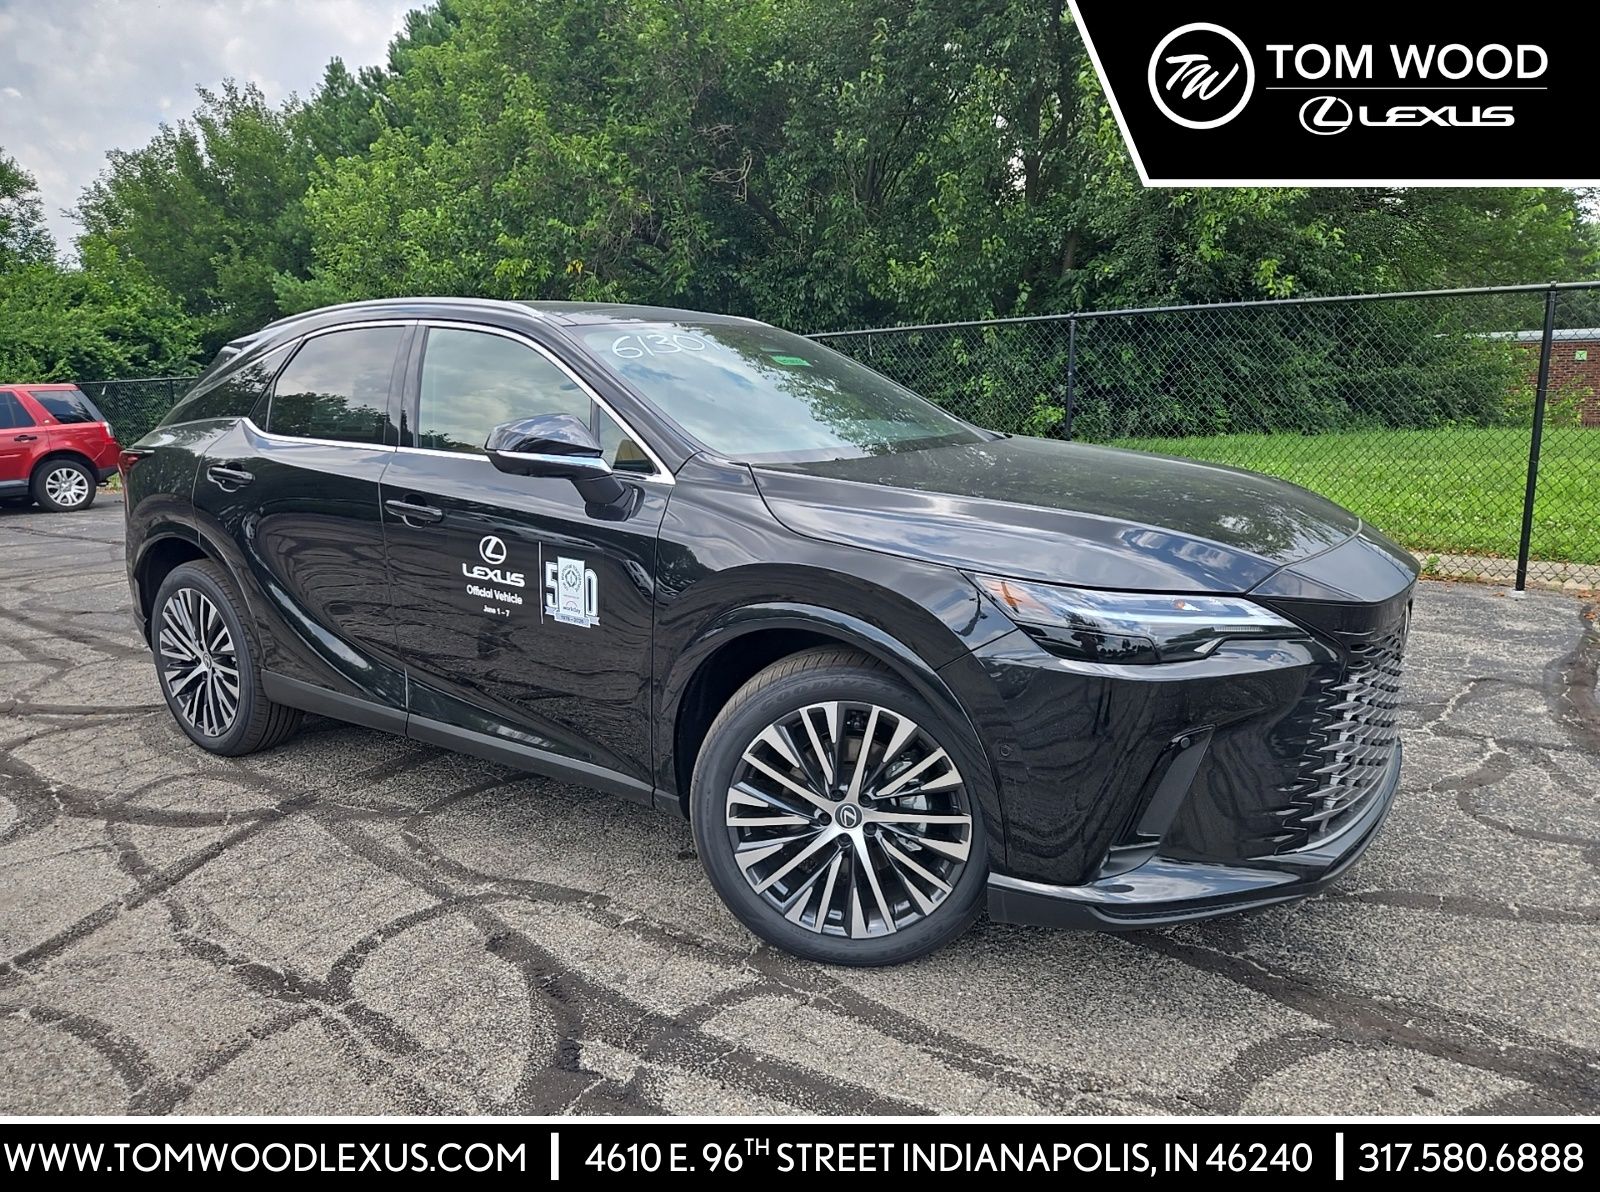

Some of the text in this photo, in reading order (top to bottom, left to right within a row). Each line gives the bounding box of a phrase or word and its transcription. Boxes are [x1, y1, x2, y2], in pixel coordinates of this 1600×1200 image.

[462, 563, 526, 588] LEXUS
[466, 584, 523, 605] Official Vehicle
[483, 604, 497, 614] June
